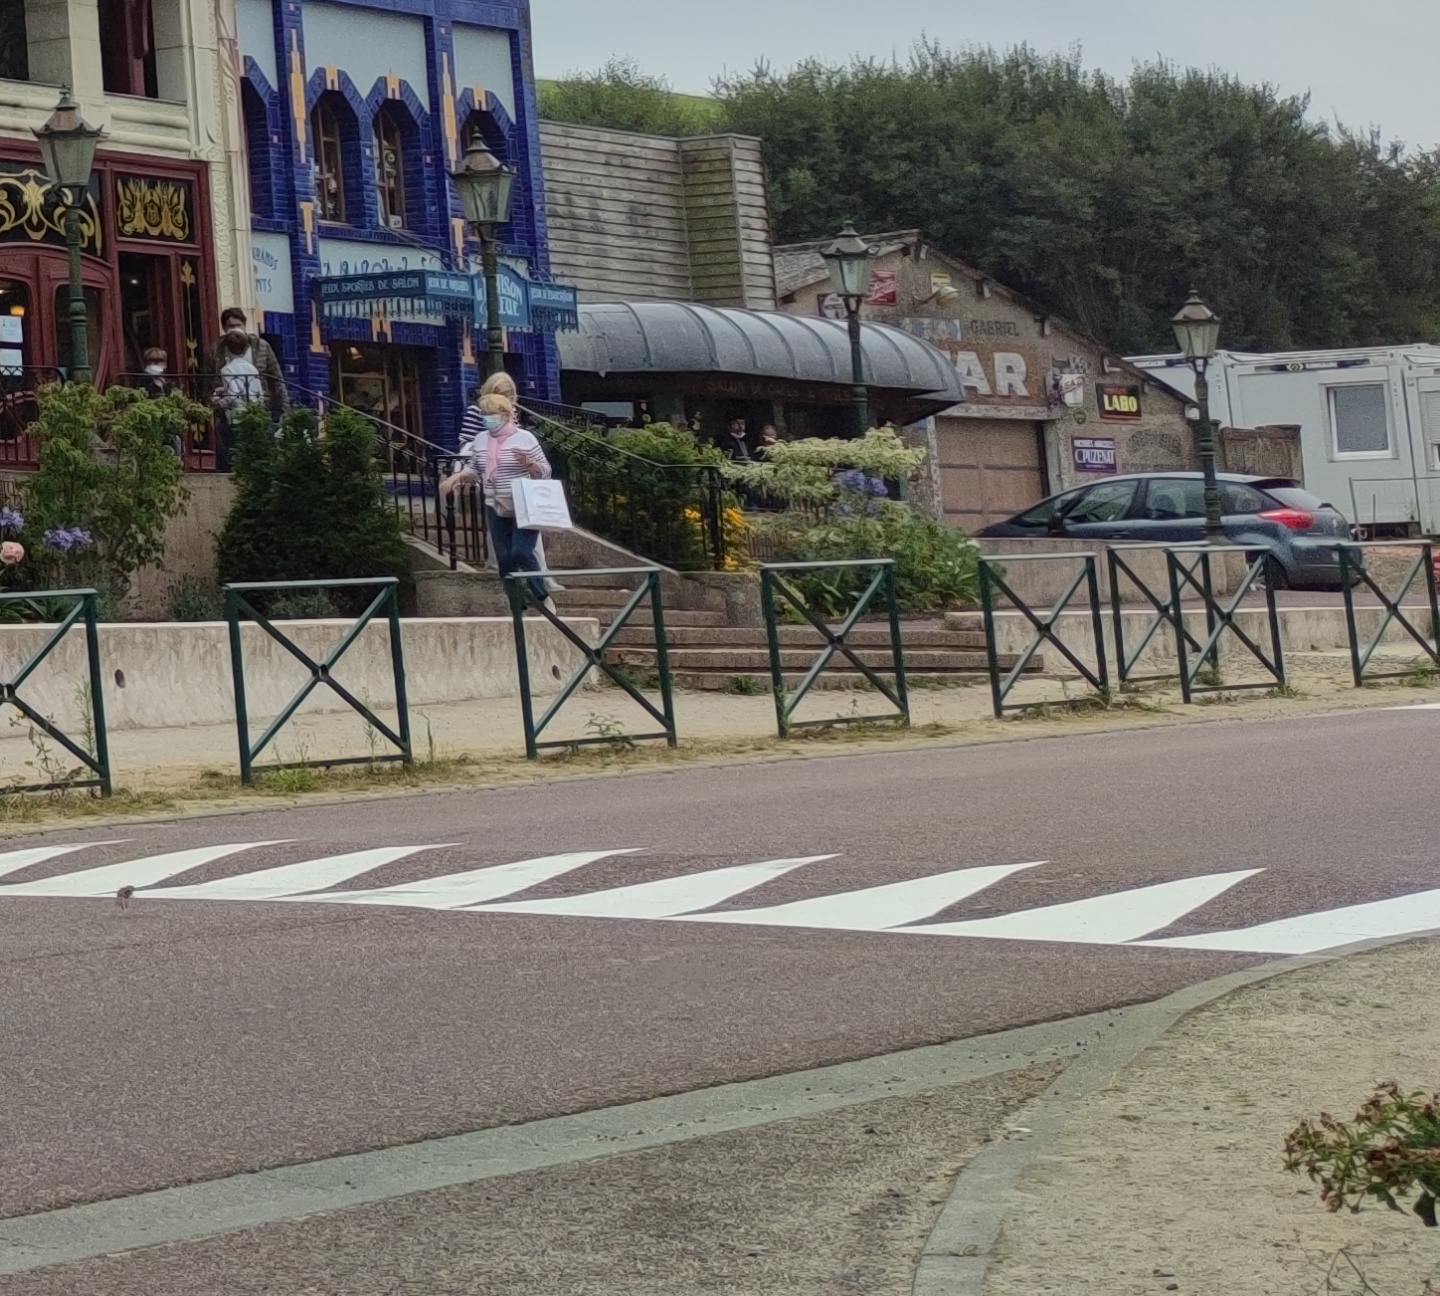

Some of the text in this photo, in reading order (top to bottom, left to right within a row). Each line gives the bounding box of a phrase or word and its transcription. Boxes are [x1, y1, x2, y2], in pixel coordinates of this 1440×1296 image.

[377, 280, 390, 290] DE
[970, 320, 1019, 337] GABRIEL
[942, 349, 1030, 396] AR
[1103, 394, 1138, 412] LABO
